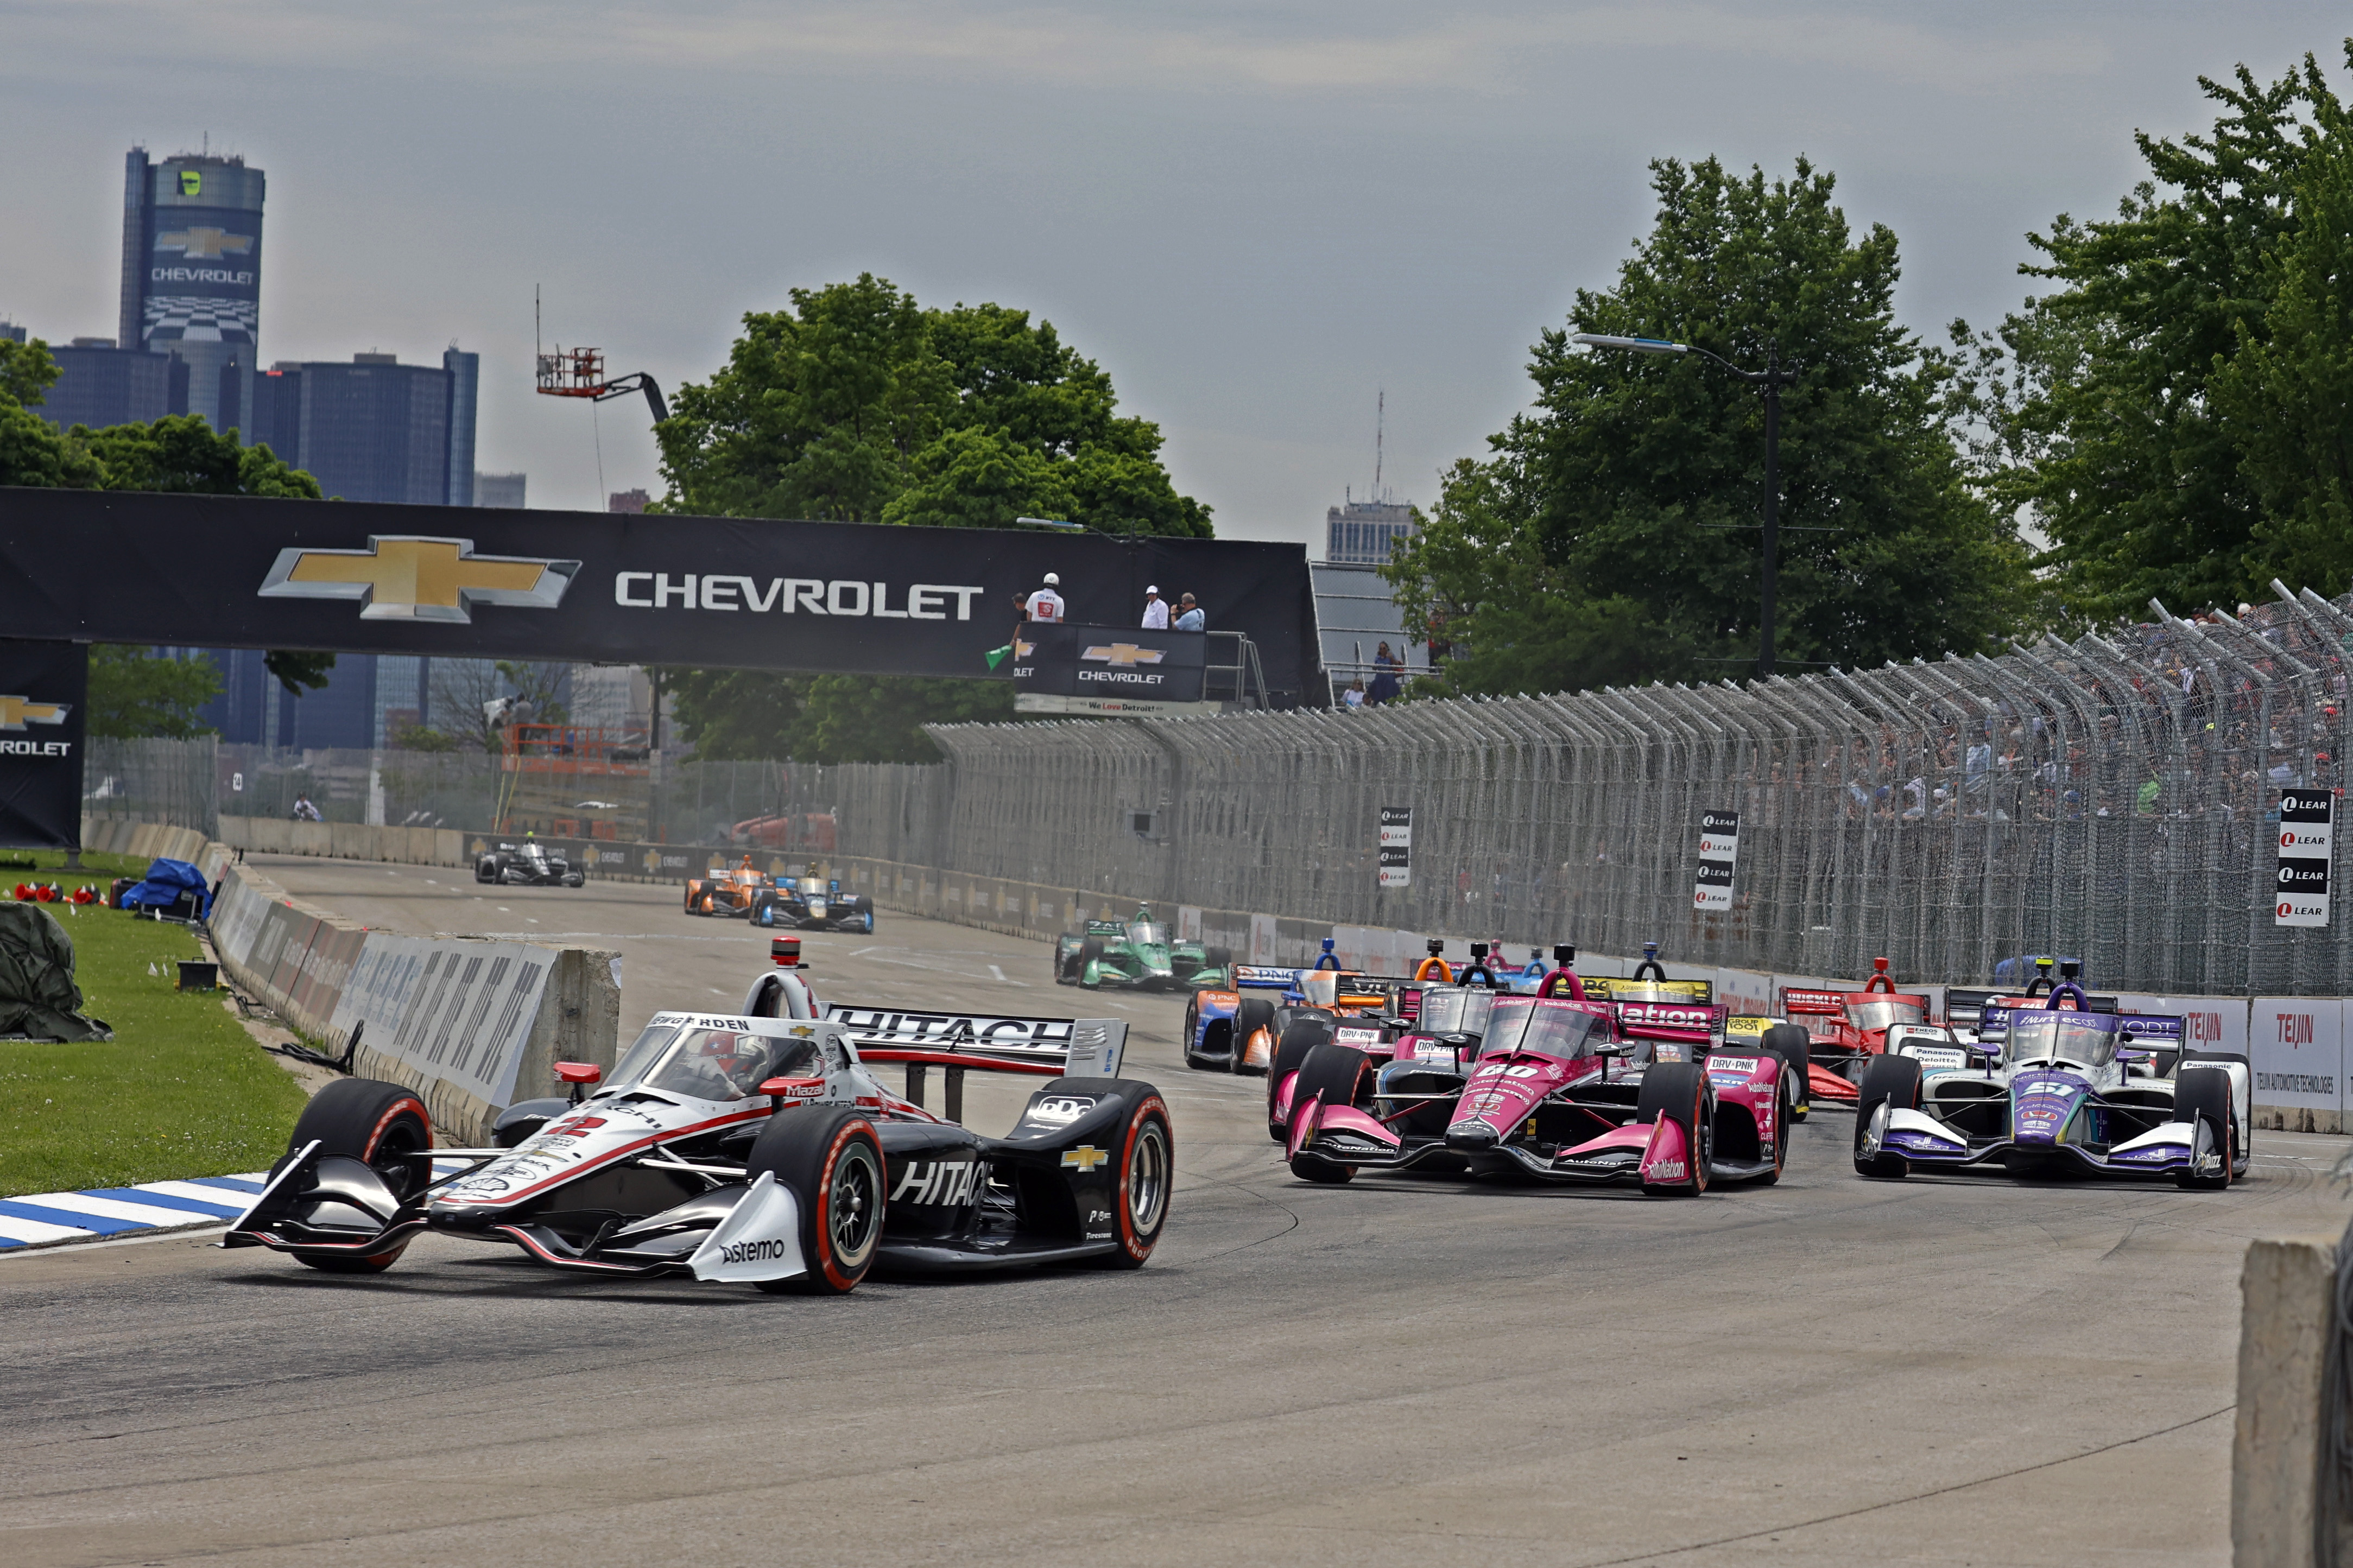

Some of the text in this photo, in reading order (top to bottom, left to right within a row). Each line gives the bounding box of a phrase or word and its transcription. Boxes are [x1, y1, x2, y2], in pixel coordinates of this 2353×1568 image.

[151, 267, 254, 285] CHEVROLET
[615, 571, 983, 620] CHEVROLET
[1079, 670, 1164, 684] CHEVROLET
[1122, 703, 1155, 712] Detroit!
[2299, 800, 2327, 809] LEAR
[2298, 836, 2325, 845] LEAR
[1710, 869, 1729, 877] LEAR
[2295, 871, 2324, 880] LEAR
[2294, 907, 2322, 916] LEAR
[1545, 1001, 1583, 1009] AutoNation
[1787, 993, 1826, 1005] HUSKI
[2127, 1020, 2175, 1035] ODT
[2188, 1012, 2222, 1046] TEIJIN
[2276, 1013, 2314, 1050] TEIJIN
[1340, 1030, 1376, 1039] DRV PNK
[1418, 1042, 1436, 1051] DRV
[1476, 1064, 1539, 1078] 60
[1712, 1059, 1754, 1070] DRV PNK
[786, 1083, 825, 1097] Mazak
[1747, 1082, 1774, 1093] AutoNation
[2020, 1081, 2076, 1097] 51
[2256, 1072, 2333, 1095] TEIJIN AUTOMOTIVE TECHNOLOGIES
[543, 1116, 608, 1138] 2
[1646, 1157, 1684, 1179] AutoNation
[1086, 1232, 1112, 1240] Firestone
[719, 1238, 785, 1265] Astemo
